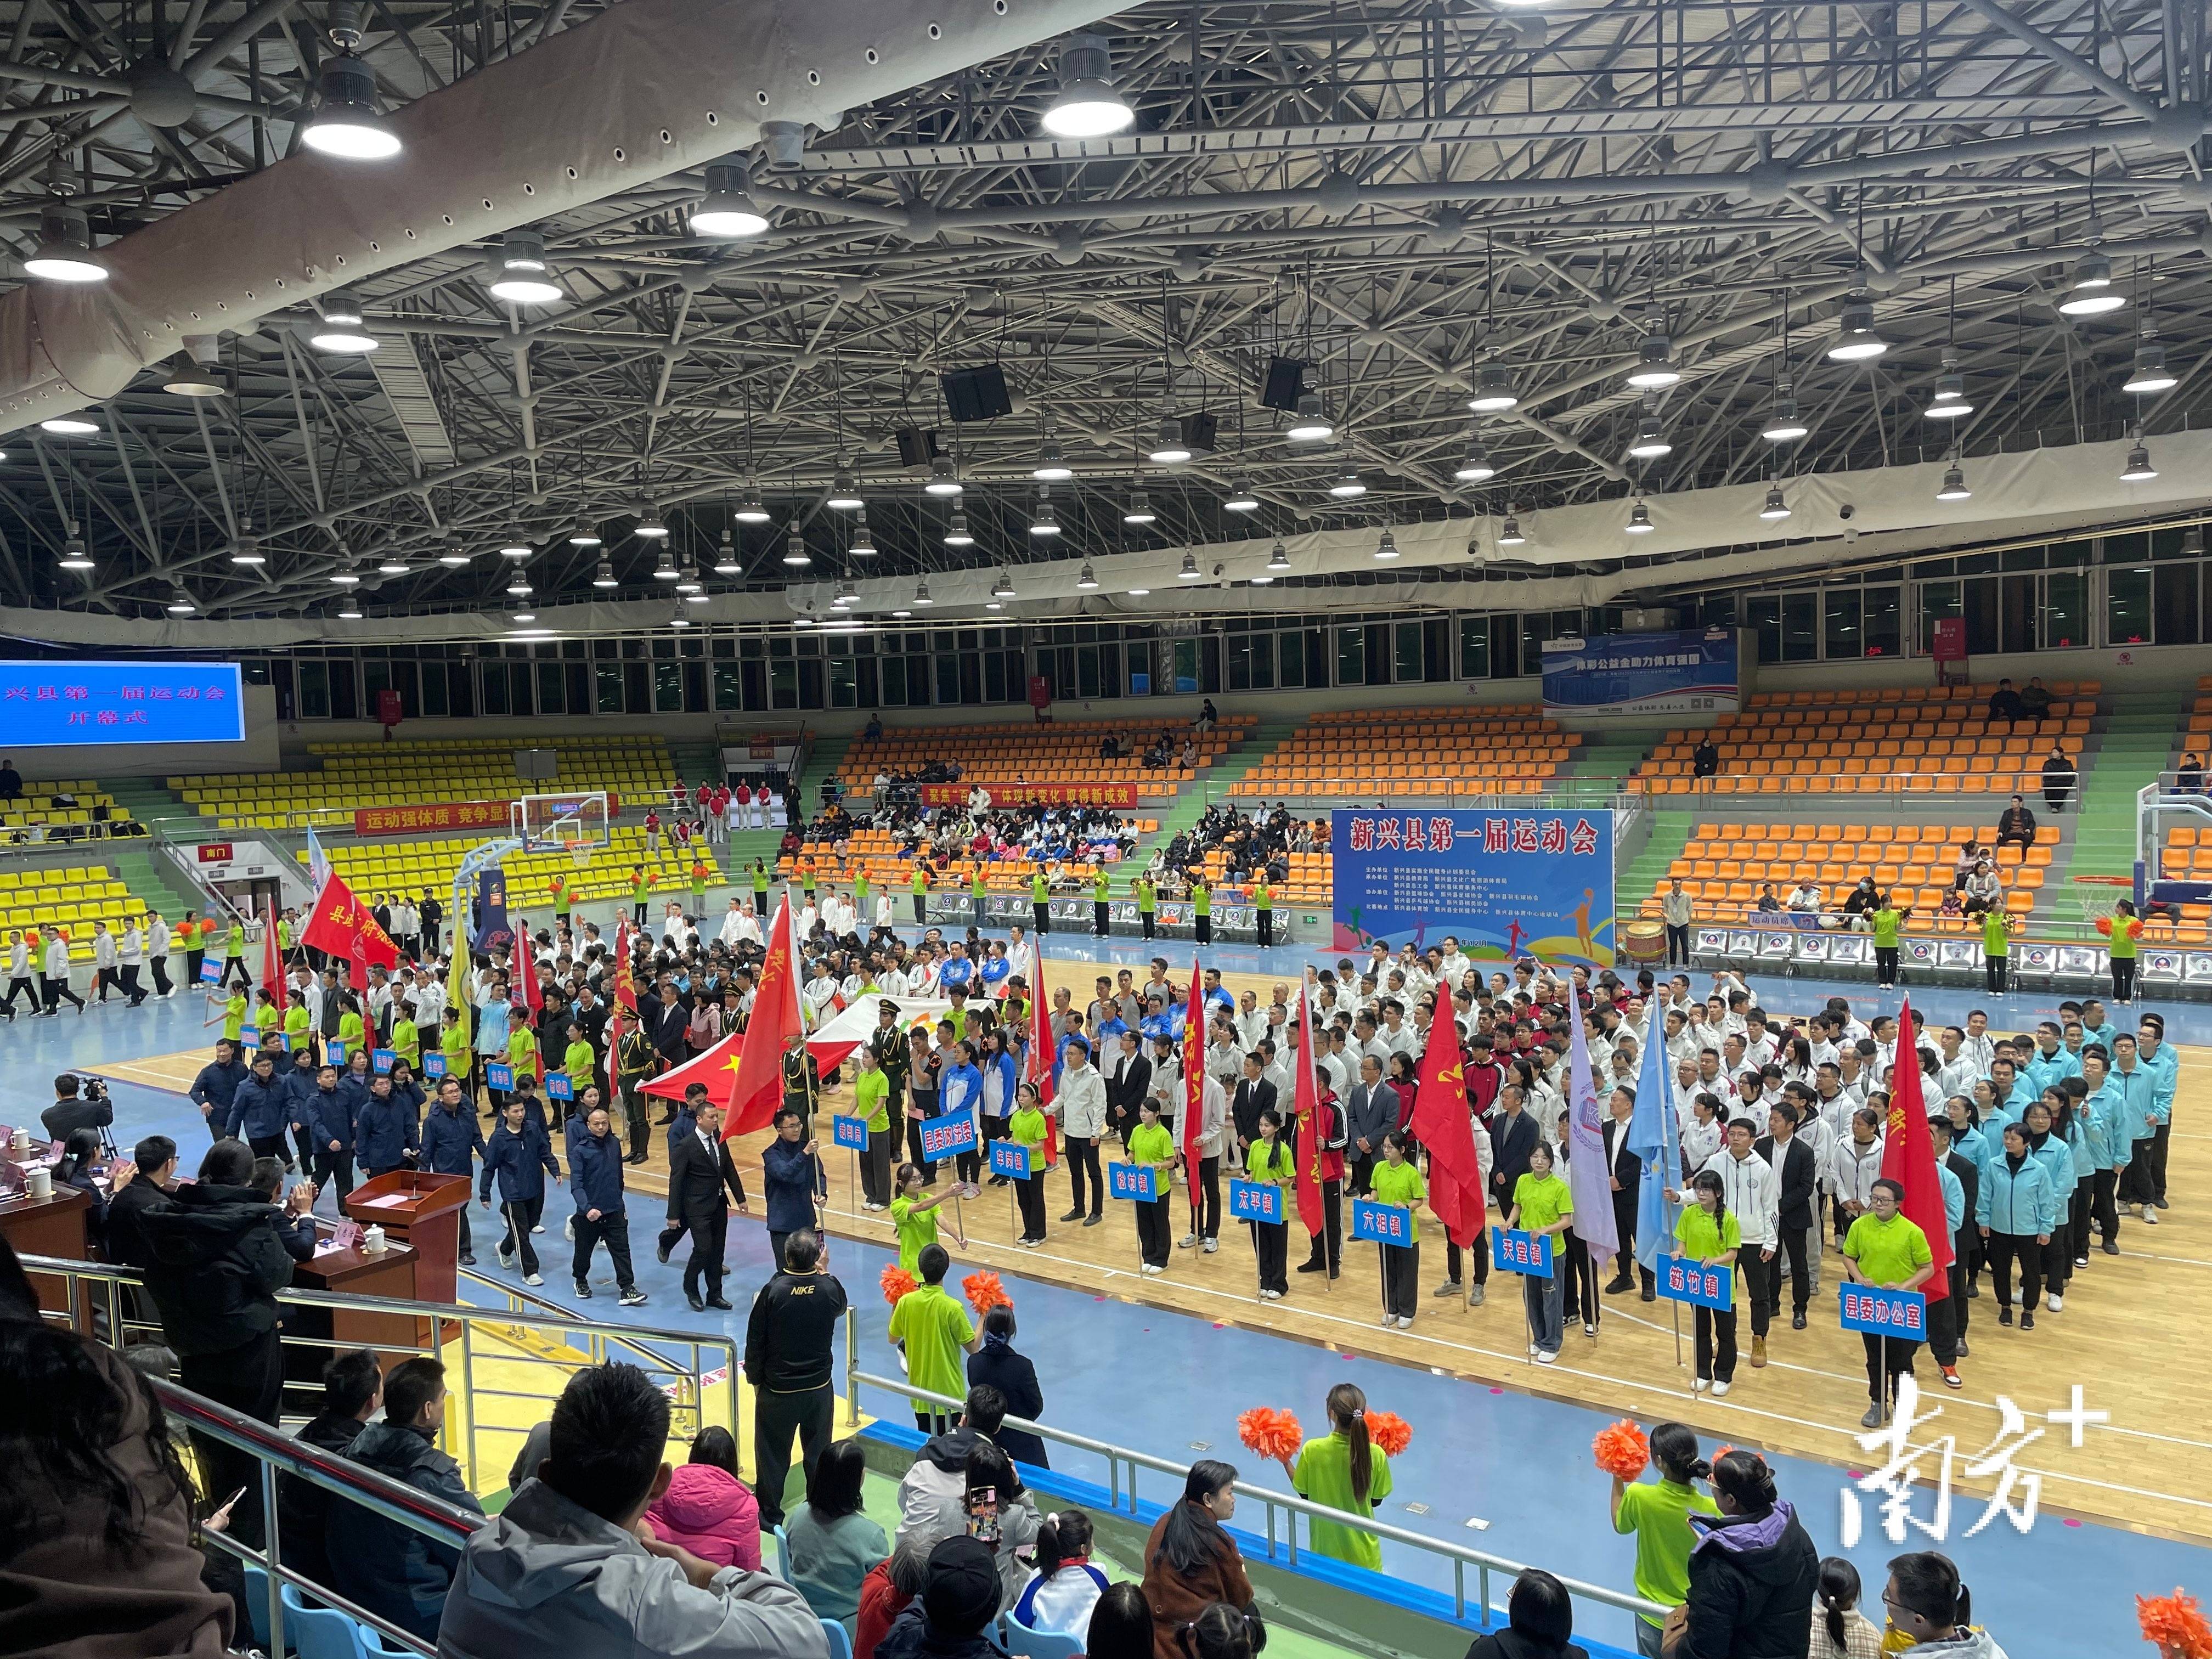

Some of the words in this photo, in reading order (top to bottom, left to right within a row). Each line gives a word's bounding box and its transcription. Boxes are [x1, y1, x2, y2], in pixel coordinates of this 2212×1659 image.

[1577, 653, 1700, 671] 体彩公益金助力体育强国
[66, 710, 150, 725] 开幕式
[1002, 789, 1060, 803] 体现新变化
[1066, 788, 1129, 804] 取得新成效
[366, 808, 450, 830] 运动强体质
[1350, 816, 1599, 855] 新兴县第一届运动会
[206, 848, 226, 857] 南门
[1393, 867, 1476, 876] 新兴县实施全民健身计划委员会
[1434, 884, 1489, 892] 新兴县体育事务中心
[1435, 876, 1508, 884] 新兴县文化广电旅游体育局
[1393, 897, 1441, 905] 新兴县乒乓球协会
[1488, 893, 1539, 901] 新兴县羽毛球协会
[1435, 906, 1489, 915] 新兴县全民健身中心
[1495, 909, 1559, 918] 新兴县体育中心运动场
[1752, 916, 1788, 926] 运动员席
[839, 1122, 862, 1143] 裁判员
[924, 1119, 973, 1154] 县委政法委
[996, 1149, 1023, 1171] 车岗镇
[1239, 1188, 1273, 1215] 太平镇
[1363, 1210, 1401, 1238] 六祖镇
[1502, 1238, 1543, 1267] 天堂镇
[790, 1285, 815, 1295] NIKE
[1844, 1294, 1922, 1330] 县委办公室
